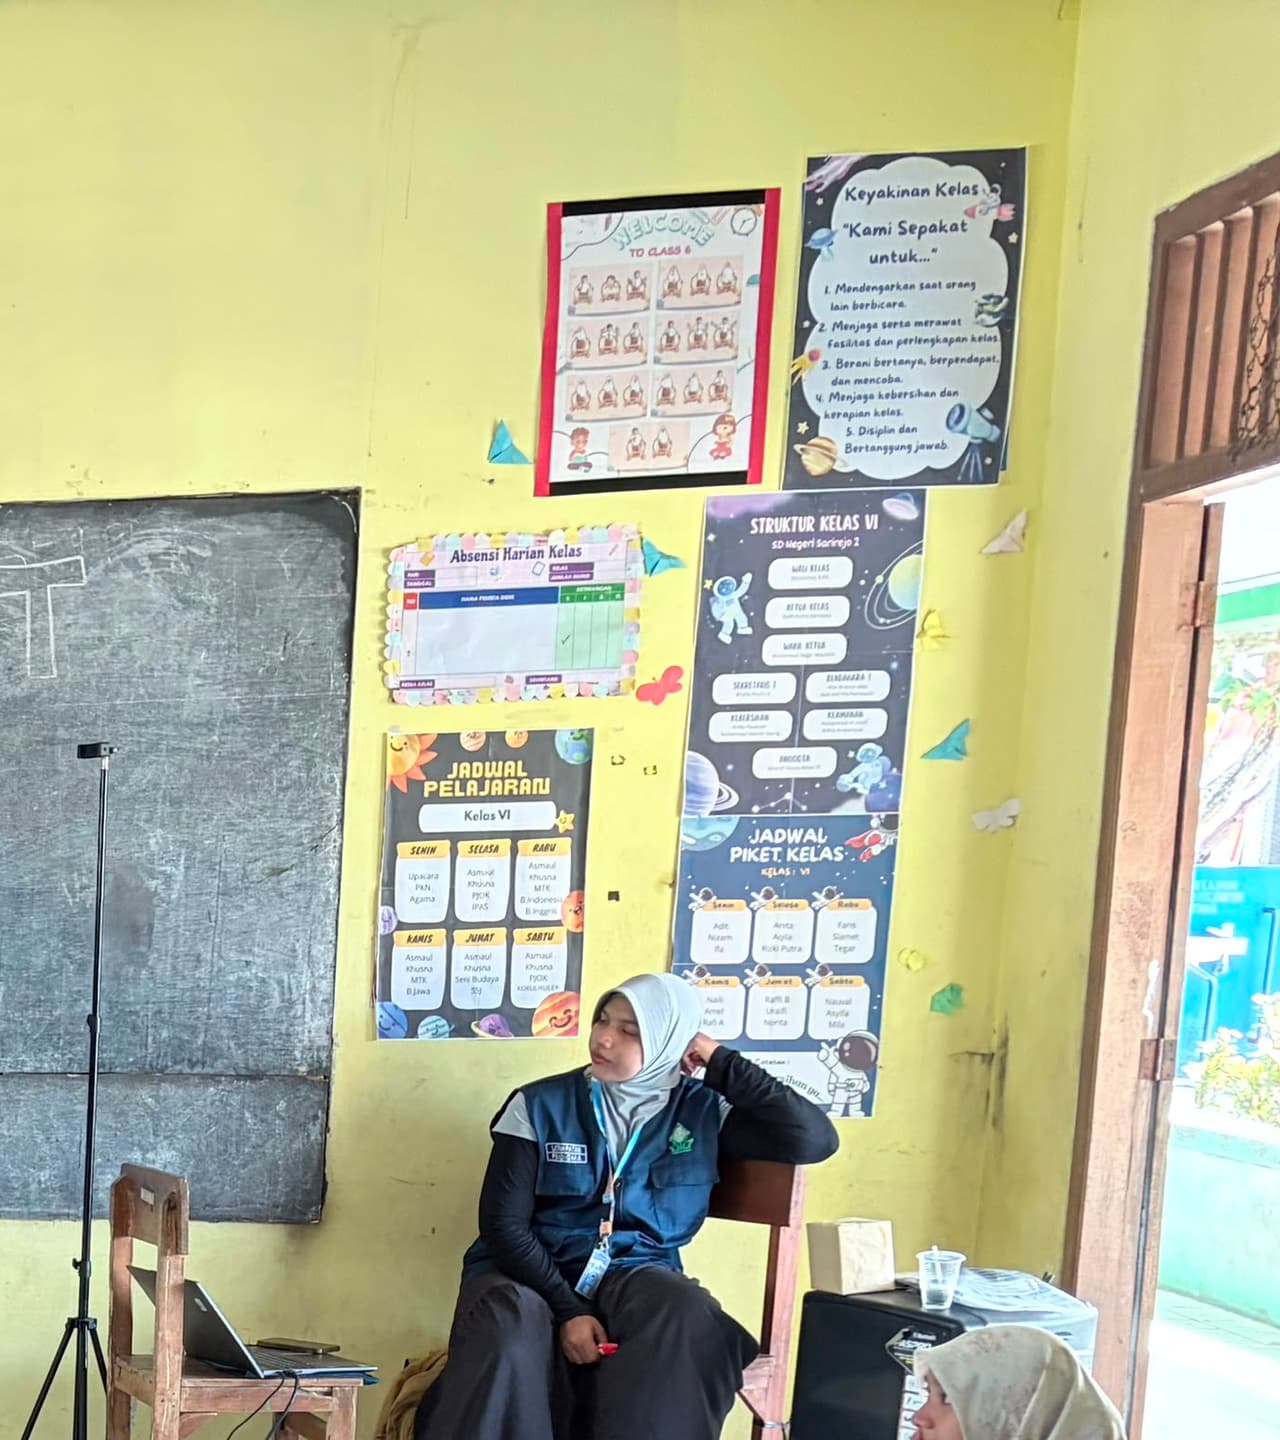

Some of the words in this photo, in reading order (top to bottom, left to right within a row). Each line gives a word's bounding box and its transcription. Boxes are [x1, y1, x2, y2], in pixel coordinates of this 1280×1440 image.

[845, 185, 930, 205] Keyakinan
[936, 182, 979, 197] Kelas
[611, 212, 715, 251] WELCOME
[898, 219, 969, 240] Sepakat
[629, 248, 644, 258] TO
[648, 246, 681, 257] CLASS
[835, 282, 916, 295] Mendengarkan
[920, 281, 942, 290] saat
[946, 280, 976, 291] orang
[831, 301, 849, 311] lain
[832, 321, 878, 333] Menjaga
[882, 319, 911, 329] serta
[914, 318, 961, 327] merawat
[874, 336, 893, 346] dan
[896, 334, 968, 349] perlengkapan
[835, 357, 871, 369] Berani
[831, 375, 851, 386] dan
[828, 392, 875, 404] Menjaga
[878, 388, 936, 400] kebersihan
[939, 388, 959, 398] dan
[823, 410, 871, 422] kerapian
[858, 425, 895, 438] Disiplin
[898, 425, 918, 434] dan
[844, 443, 913, 455] Bertanggung
[750, 516, 815, 534] STRUKTUR
[819, 514, 860, 532] KELAS
[865, 514, 879, 530] VI
[772, 540, 784, 549] SD
[785, 538, 815, 550] Negeri
[816, 537, 852, 549] Sarirejo
[450, 549, 499, 564] Absensi
[503, 546, 546, 561] Harian
[548, 545, 583, 559] Kelas
[447, 760, 527, 779] JADWAL
[424, 778, 551, 798] PELAJARAN
[464, 810, 496, 822] Kelas
[498, 809, 511, 820] VI
[750, 827, 828, 844] JADWAL
[410, 846, 437, 855] SENIN
[468, 844, 499, 854] SELASA
[532, 843, 557, 852] RABU
[730, 848, 780, 863] PIKET
[787, 846, 844, 862] KELAS
[409, 896, 435, 904] Agama
[407, 934, 433, 943] KAMIS
[466, 933, 495, 943] JUMAT
[526, 932, 555, 941] SABTU
